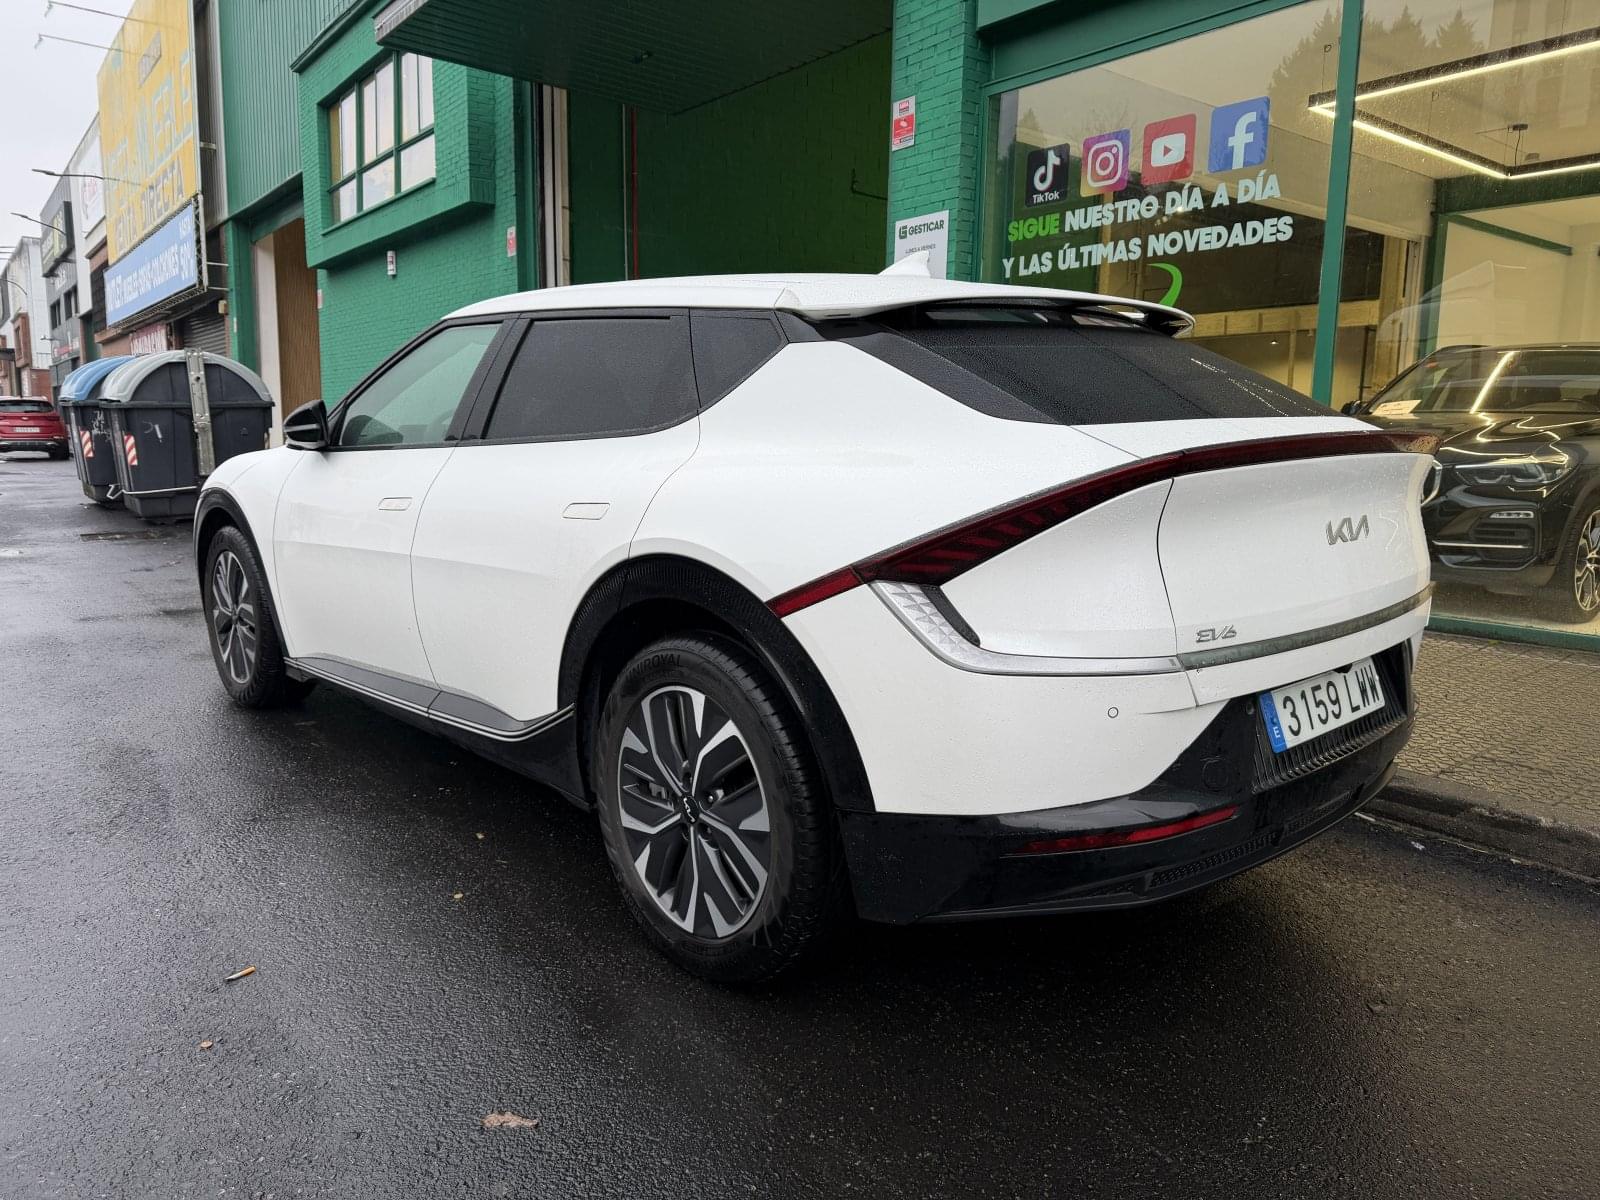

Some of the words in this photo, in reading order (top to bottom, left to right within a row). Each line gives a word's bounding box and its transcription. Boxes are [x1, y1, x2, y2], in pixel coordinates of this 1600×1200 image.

[1008, 213, 1060, 242] SIGUE
[1065, 194, 1159, 233] NUESTRO
[1165, 181, 1204, 215] DÍA
[1211, 182, 1230, 208] A
[1237, 169, 1281, 204] DÍA
[1032, 190, 1060, 204] TikTok
[908, 219, 945, 236] GESTICAR
[1002, 256, 1015, 279] Y
[1018, 250, 1053, 277] LAS
[1057, 242, 1142, 271] ÚLTIMAS
[1147, 215, 1294, 257] NOVEDADES
[1325, 514, 1370, 546] KIA
[1196, 624, 1237, 643] EV6
[1283, 680, 1342, 736] 3159
[1343, 664, 1380, 713] LWW
[1272, 726, 1281, 738] E
